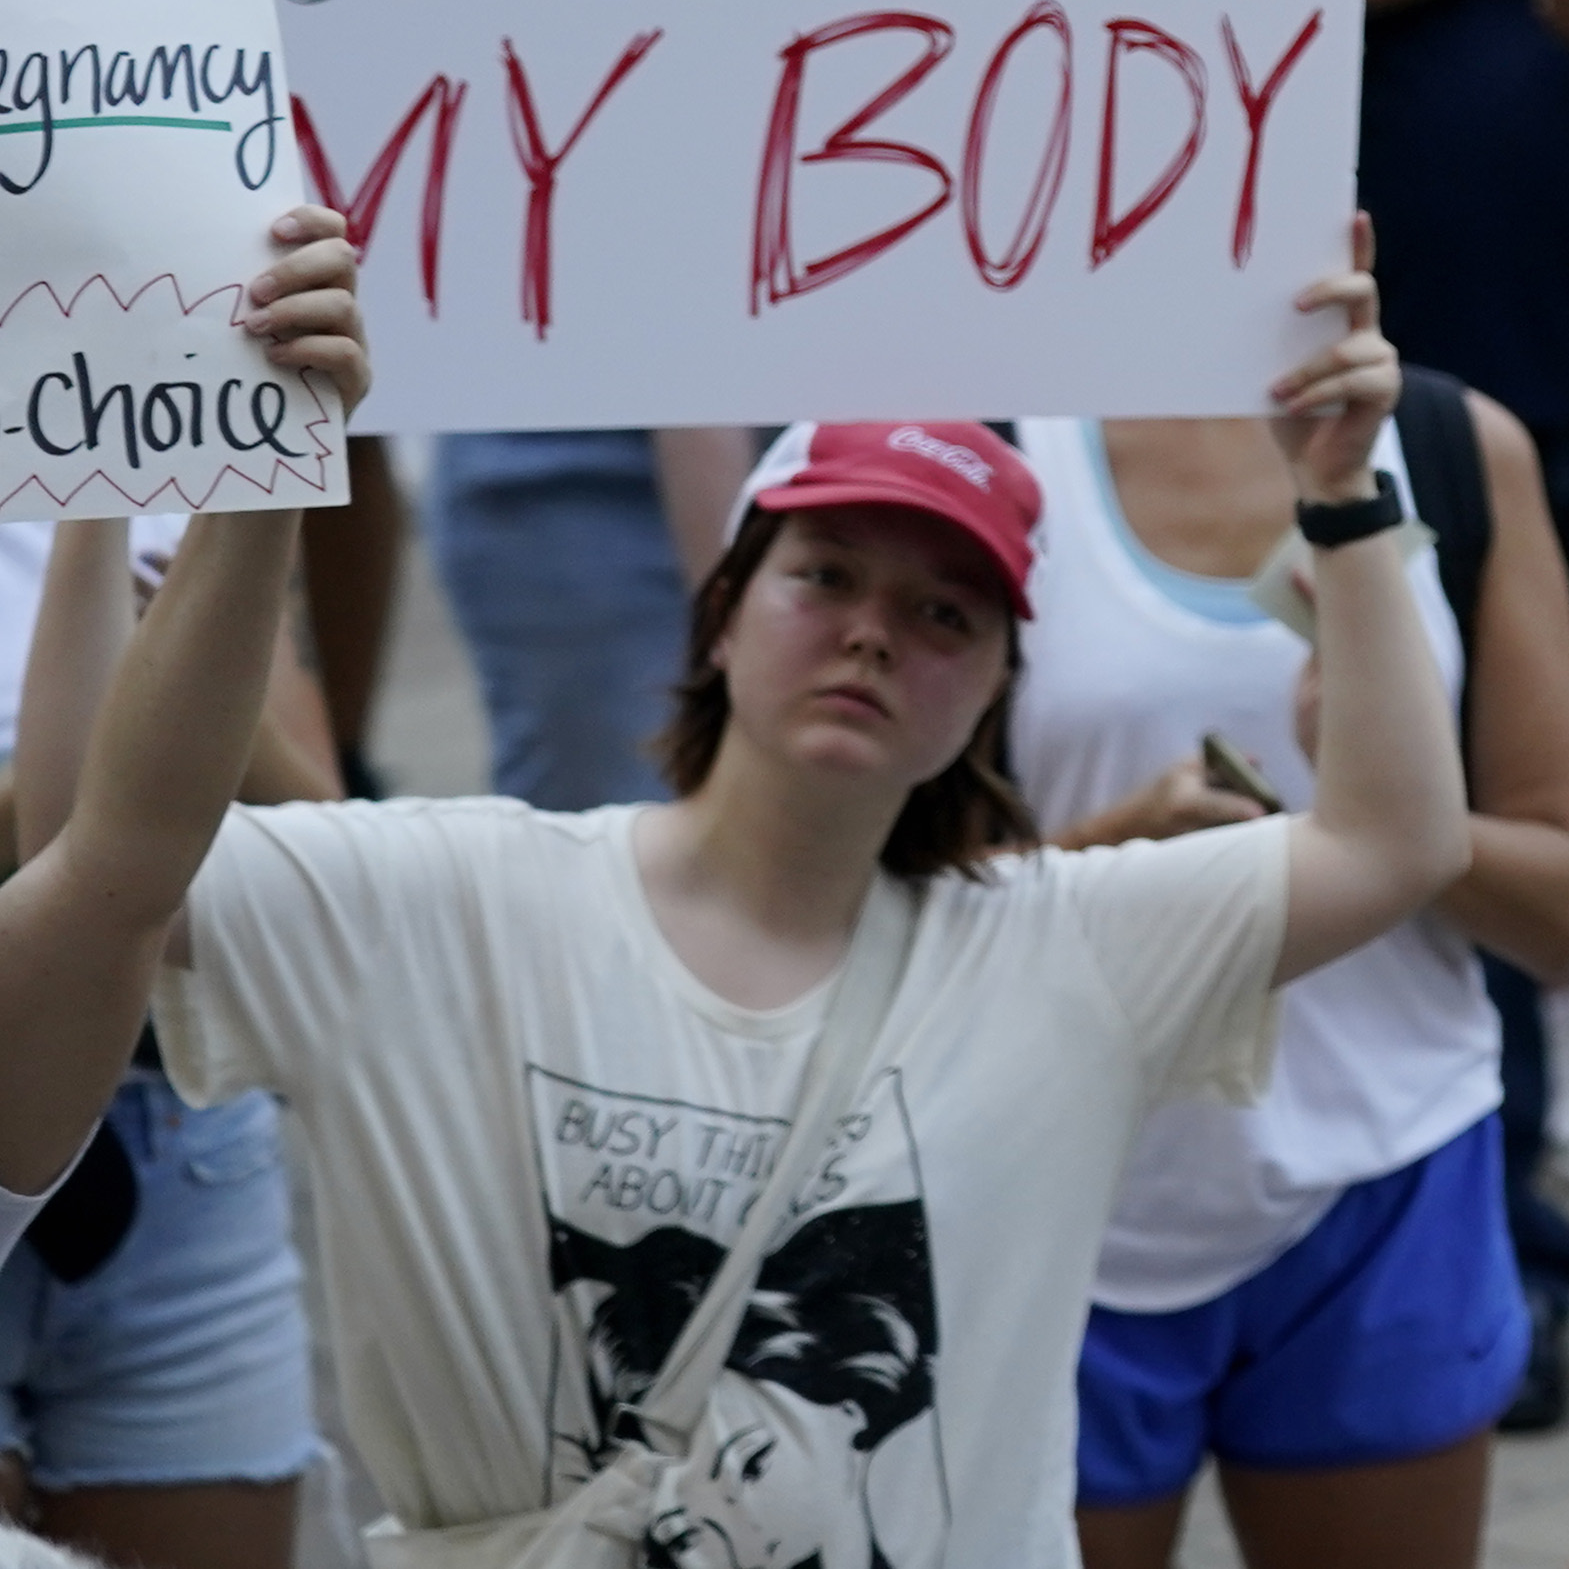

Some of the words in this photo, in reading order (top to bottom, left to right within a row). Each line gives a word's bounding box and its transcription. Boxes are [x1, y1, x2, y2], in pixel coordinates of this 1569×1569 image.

[290, 29, 664, 341] MY
[750, 0, 1324, 319] BODY
[554, 1099, 680, 1162] BUSY
[579, 1162, 730, 1224] ABOUT
